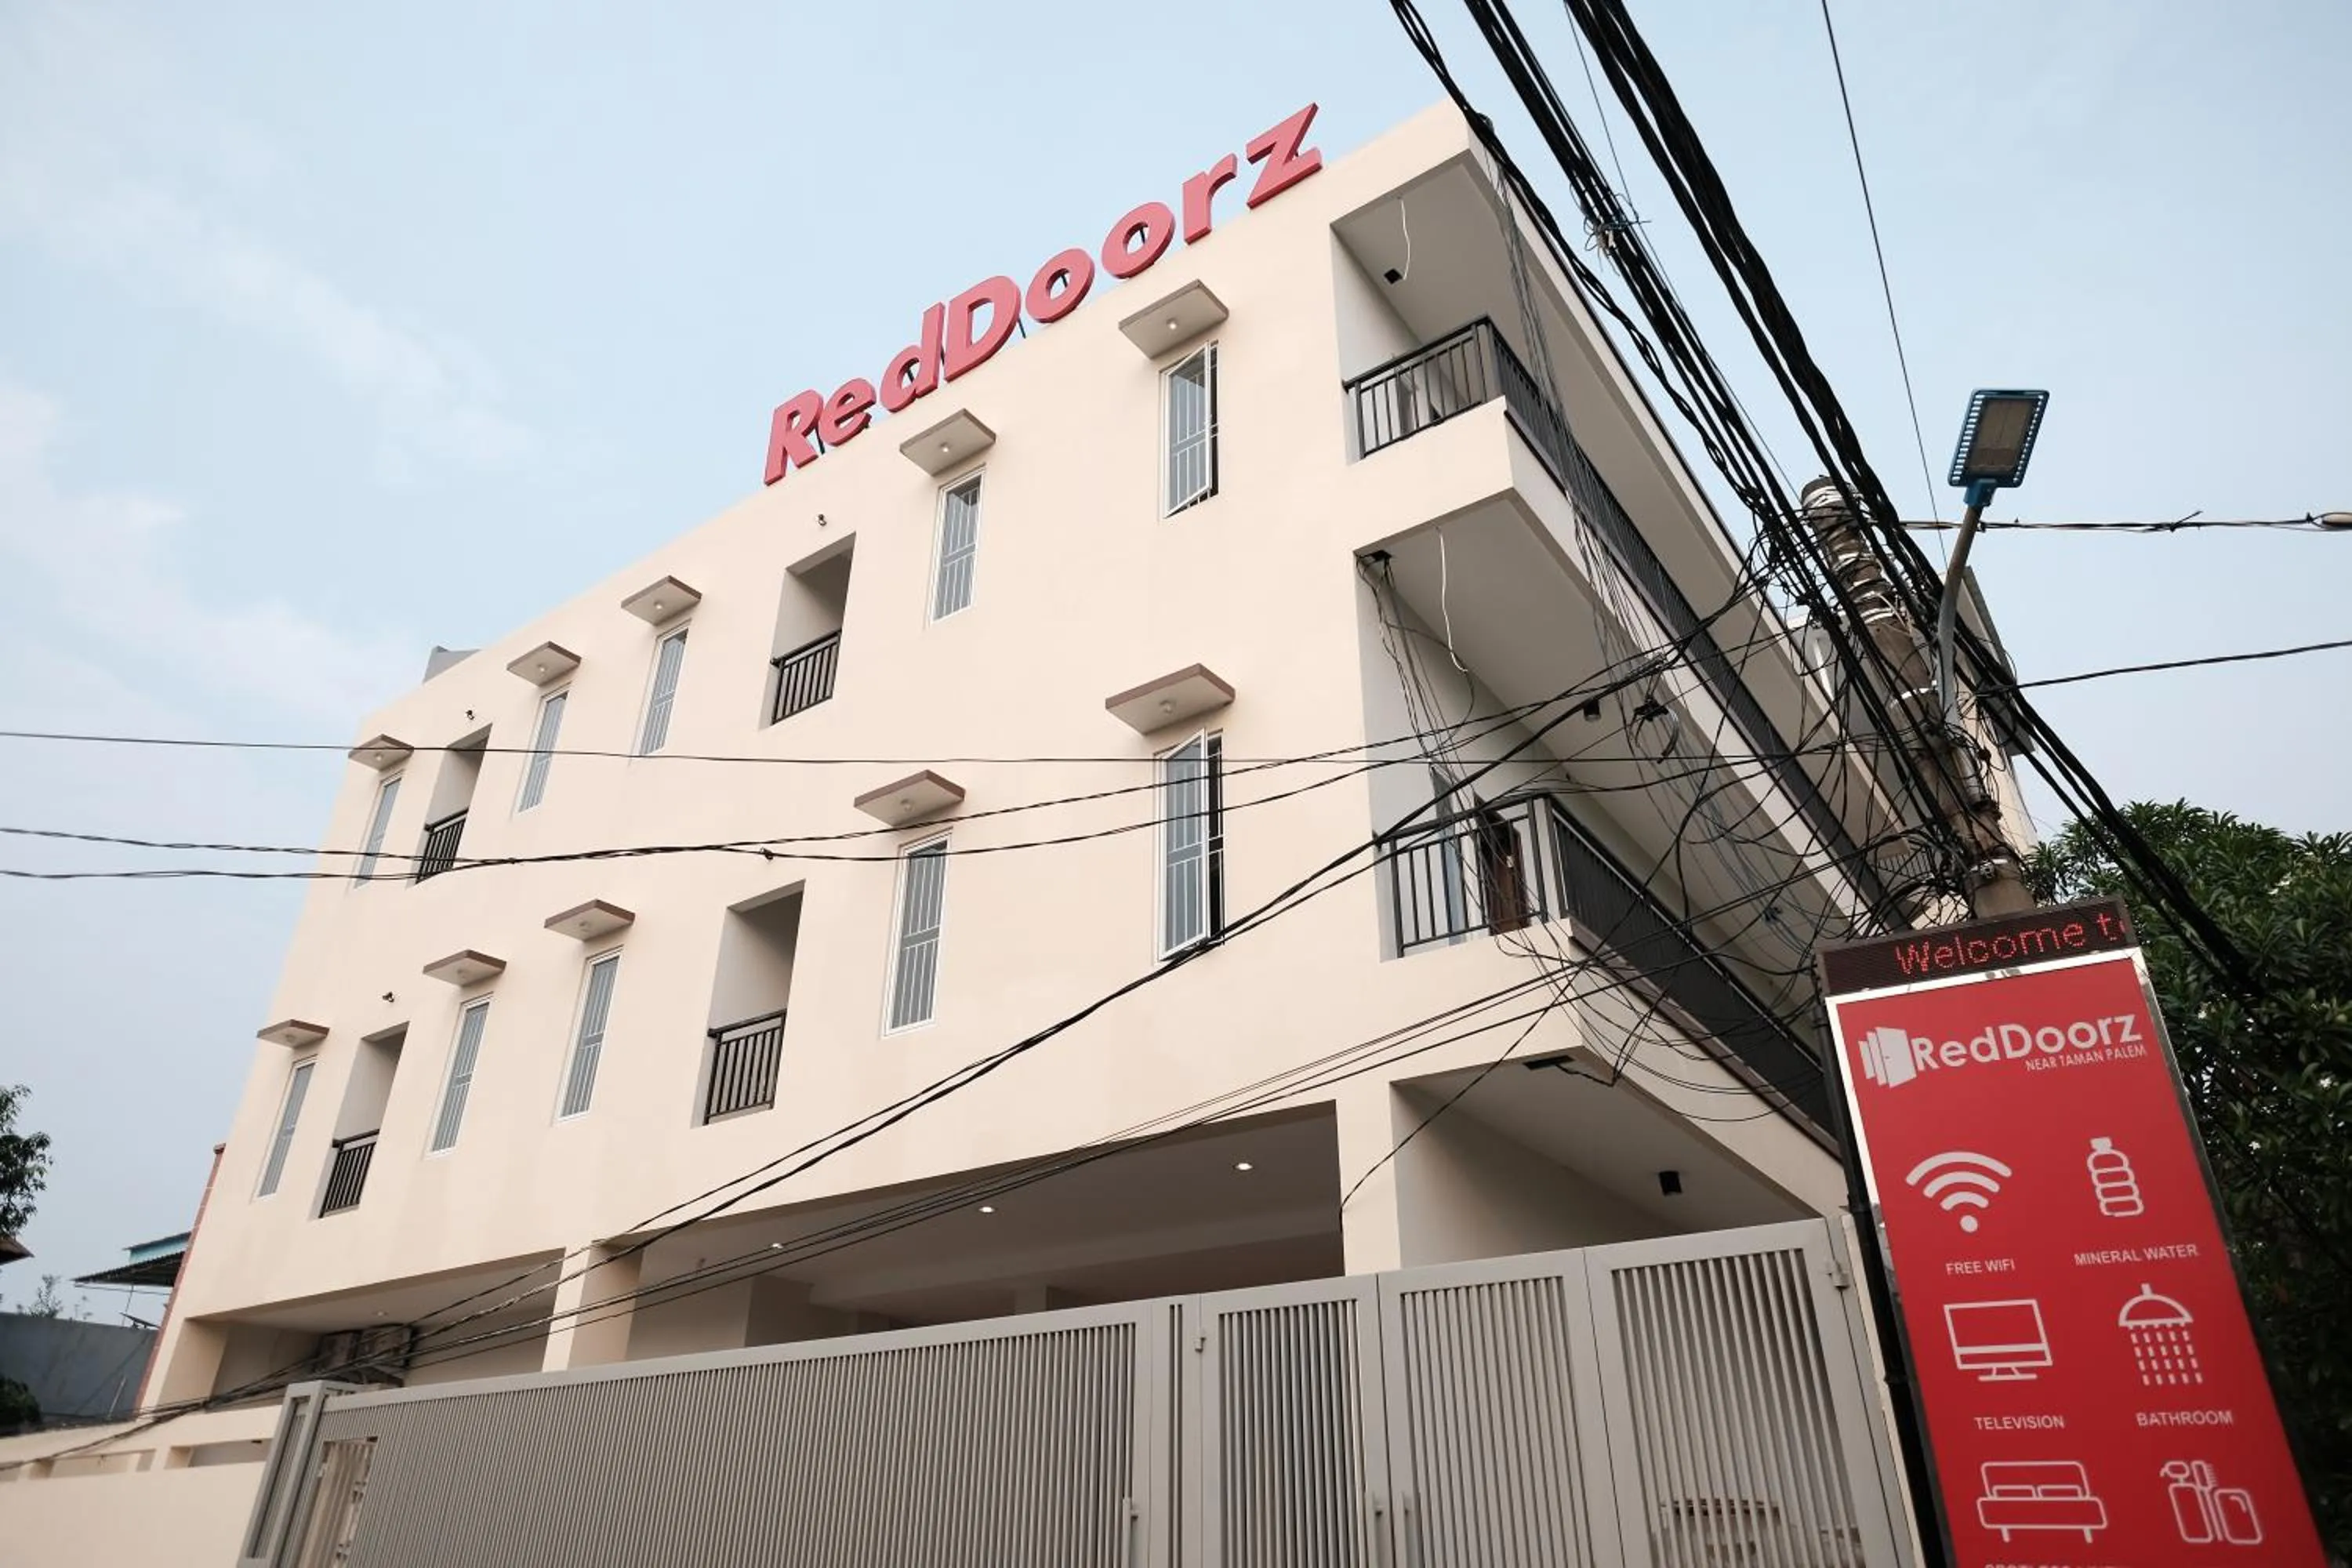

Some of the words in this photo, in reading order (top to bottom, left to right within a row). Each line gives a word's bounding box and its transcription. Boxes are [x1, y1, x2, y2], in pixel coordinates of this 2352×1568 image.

[764, 102, 1323, 486] RedDoorz
[1895, 923, 2085, 975] Welcome
[2096, 913, 2125, 942] t
[1911, 1014, 2142, 1072] RedDoorz
[2025, 1058, 2057, 1072] NEAR
[2060, 1053, 2104, 1067] TAMAN
[2106, 1044, 2147, 1061] PALEM
[1945, 1261, 1983, 1276] FREE
[1985, 1258, 2016, 1272] WIFI
[2074, 1247, 2142, 1266] MINERAL
[2143, 1243, 2199, 1261] WATER
[1973, 1414, 2066, 1430] TELEVISION
[2136, 1410, 2234, 1427] BATHROOM
